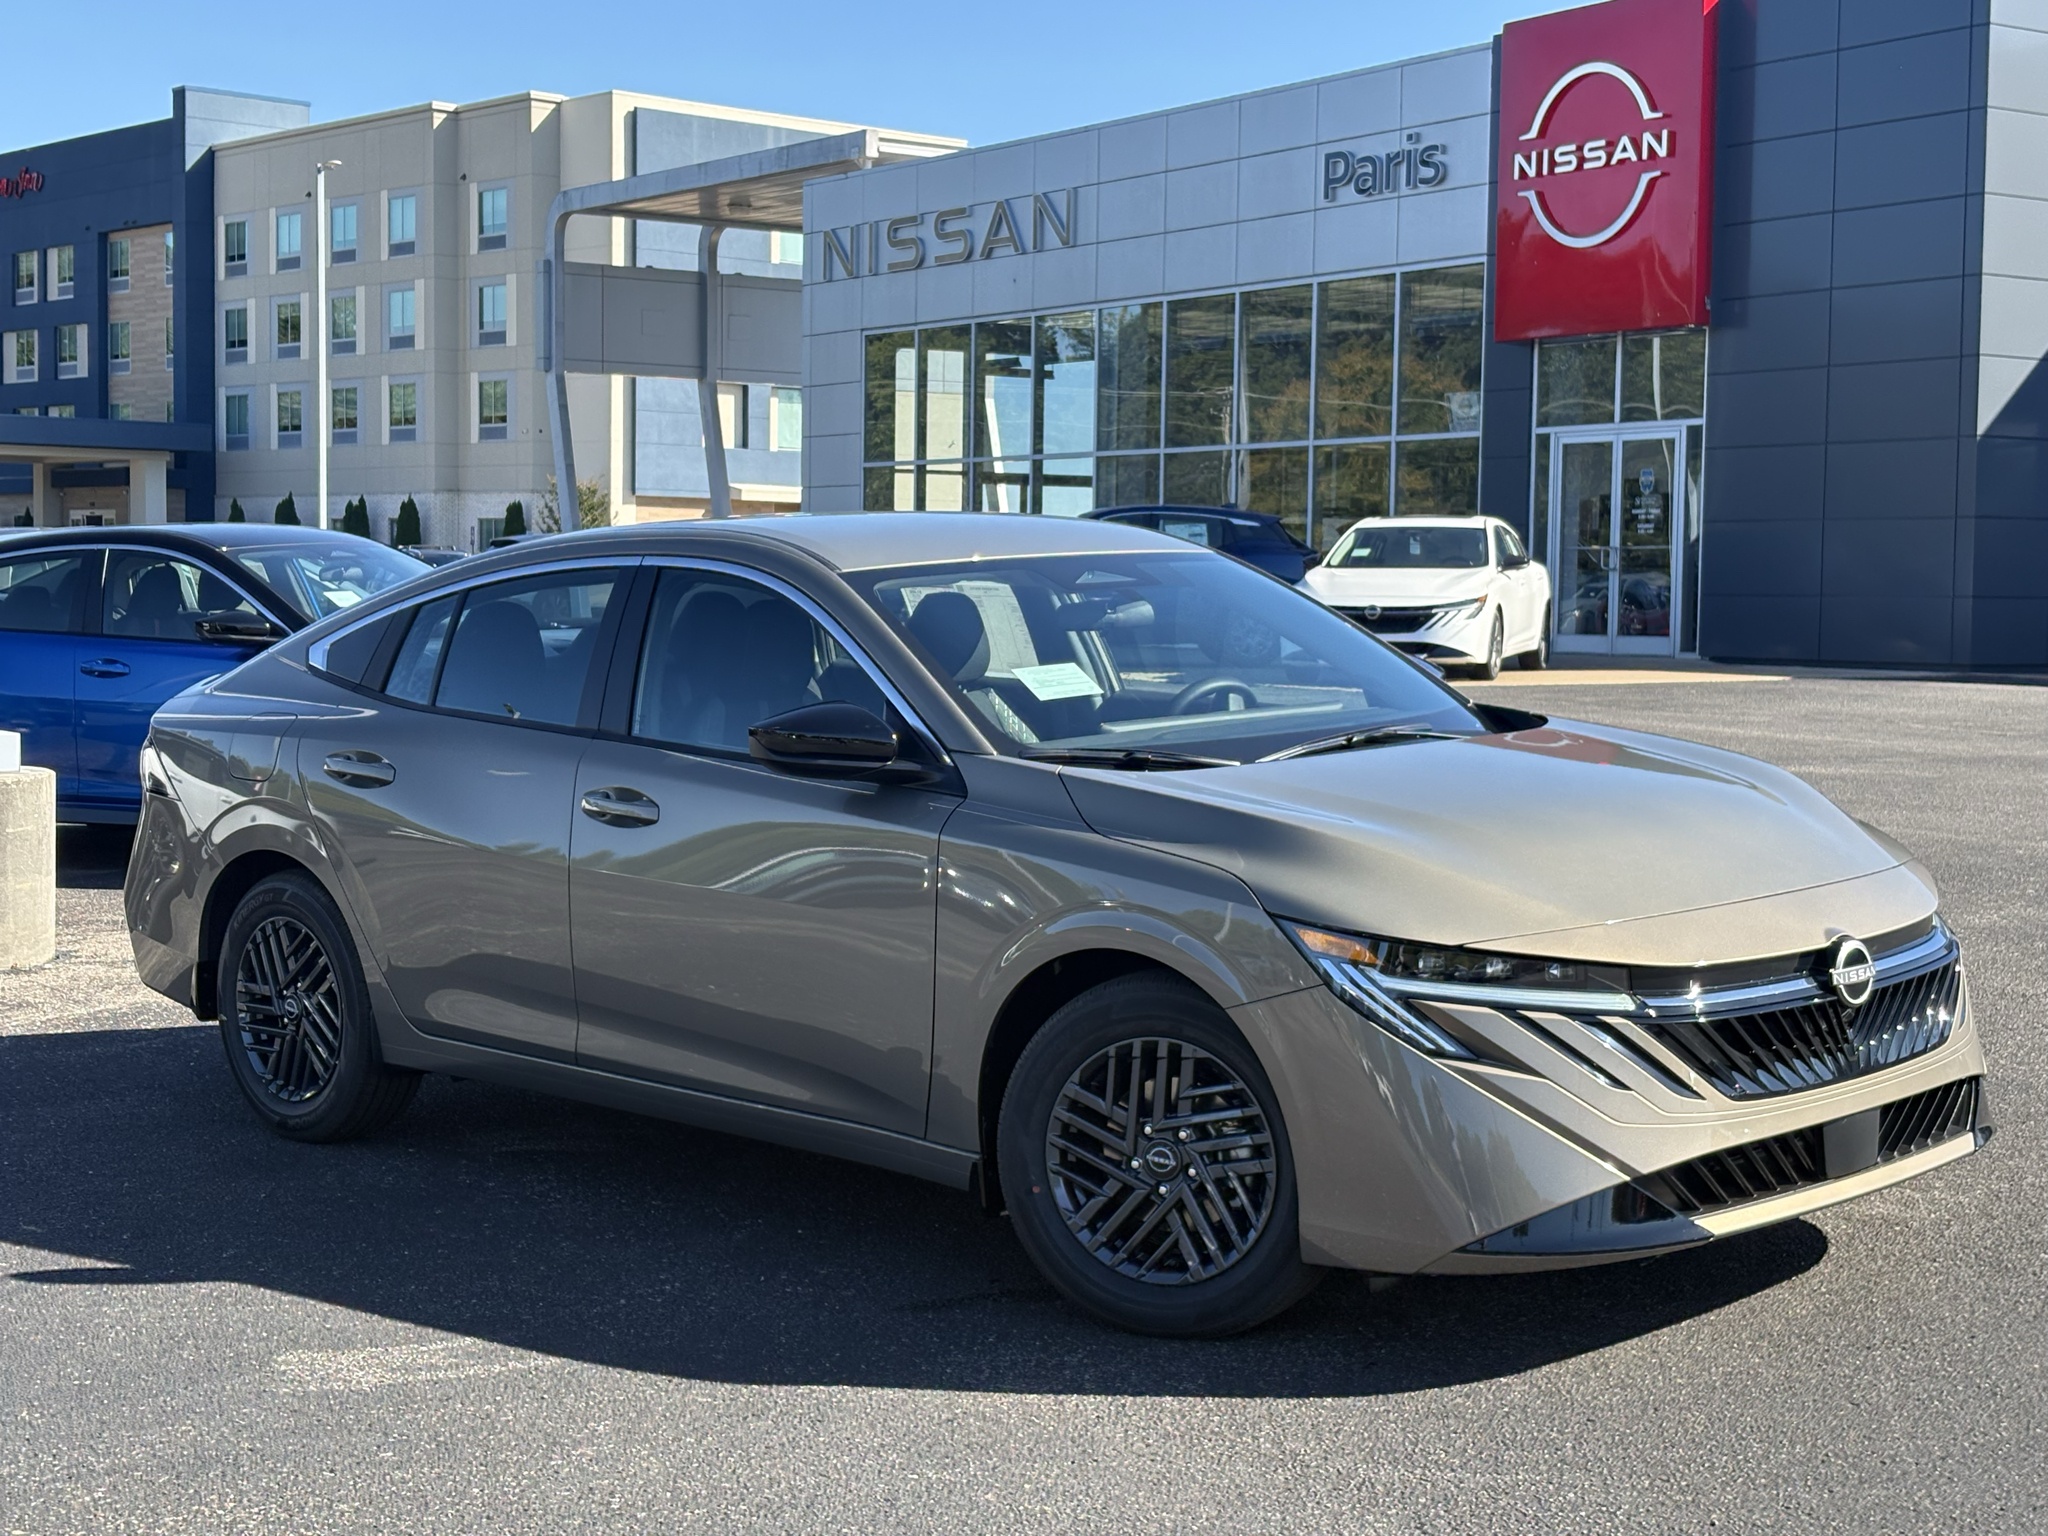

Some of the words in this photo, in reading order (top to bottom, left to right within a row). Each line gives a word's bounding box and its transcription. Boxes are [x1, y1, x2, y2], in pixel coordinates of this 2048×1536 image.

[1323, 132, 1446, 202] Paris
[1513, 129, 1669, 181] NISSAN
[822, 188, 1073, 282] NISSAN
[1832, 965, 1876, 986] NISSAN
